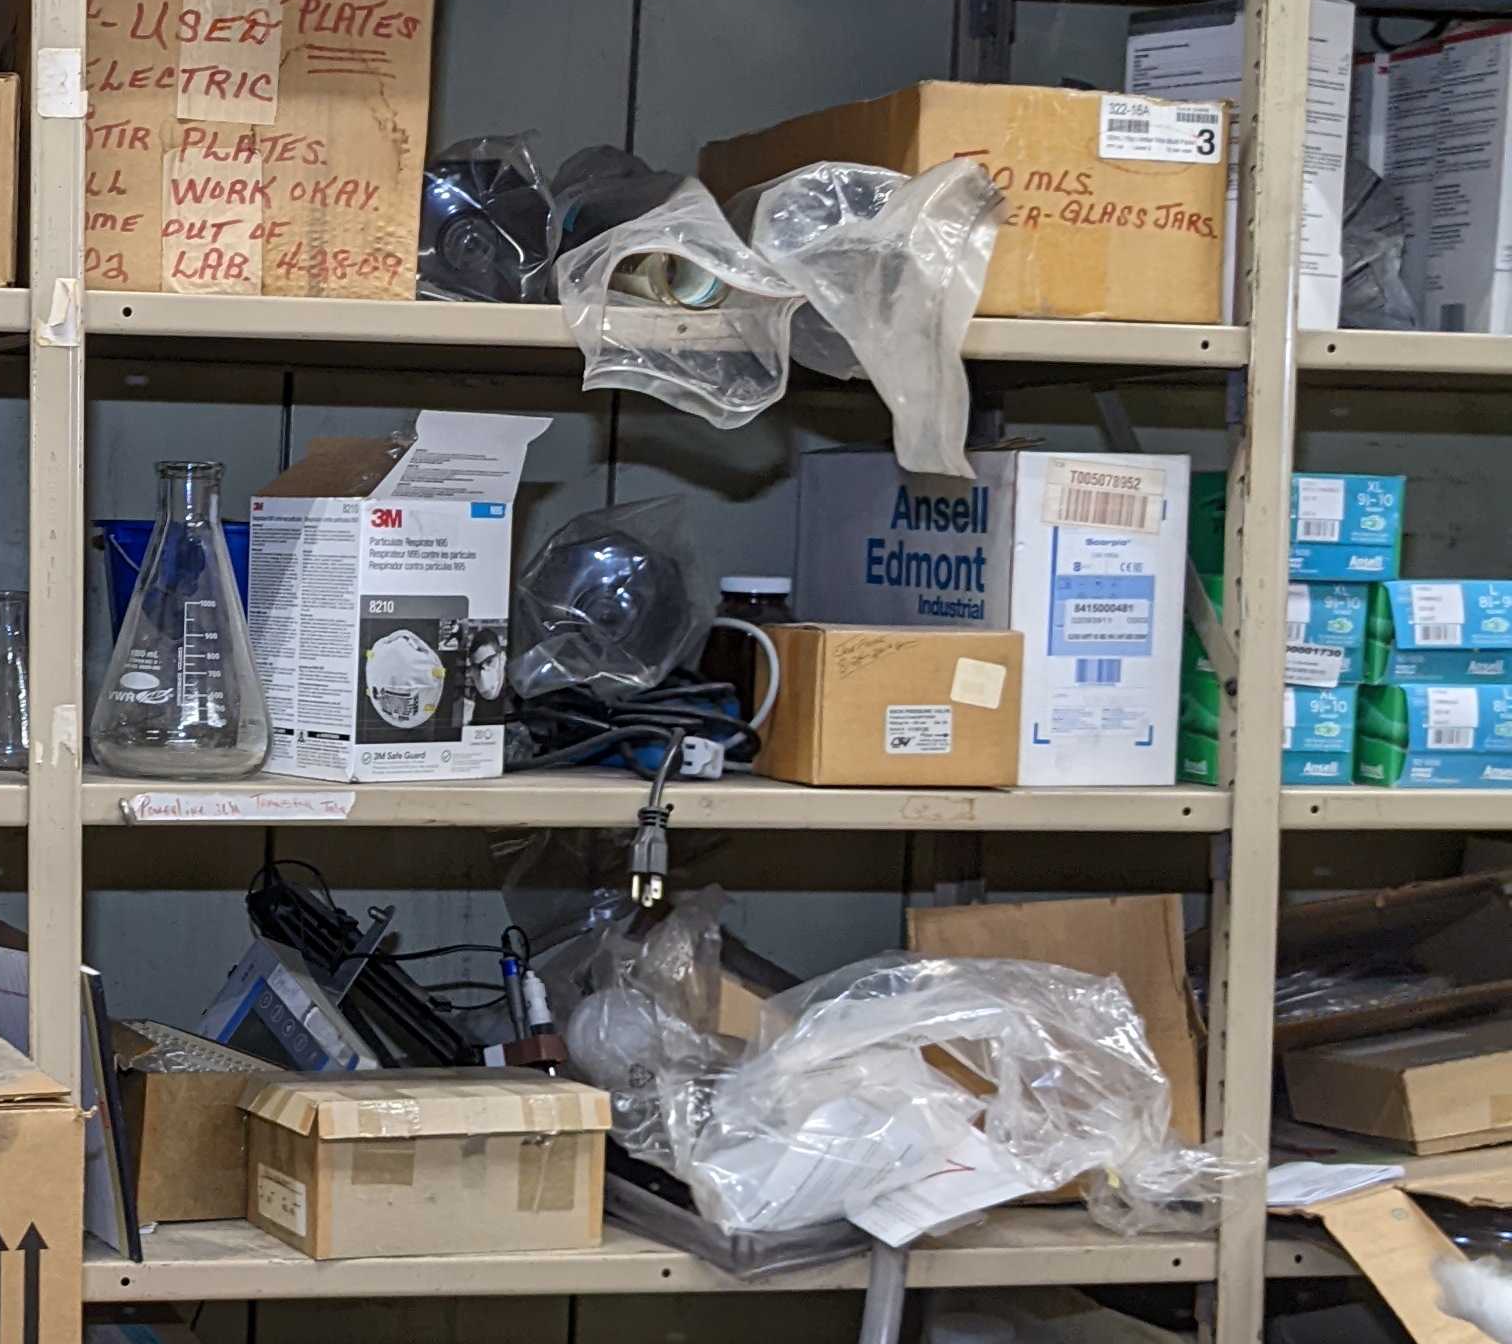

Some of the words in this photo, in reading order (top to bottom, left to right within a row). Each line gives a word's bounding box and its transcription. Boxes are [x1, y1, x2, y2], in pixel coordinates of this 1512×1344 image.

[130, 2, 284, 49] USED
[180, 126, 327, 166] PLATES.
[1196, 129, 1216, 156] 3
[172, 176, 276, 207] WORK
[291, 177, 380, 212] OKAY.
[161, 217, 243, 241] OUT
[249, 219, 292, 243] OF
[1153, 203, 1218, 239] JARS.
[171, 247, 252, 282] LAB.
[1367, 481, 1383, 493] XL
[371, 509, 402, 528] 3M
[891, 485, 988, 533] Ansell
[369, 537, 403, 547] Particulate
[405, 538, 434, 548] Respirator
[435, 538, 448, 547] N95
[369, 550, 406, 560] Respirateur
[450, 550, 477, 560] particules
[369, 562, 403, 572] Respirador
[405, 562, 424, 570] contra
[866, 538, 986, 592] Edmont
[1350, 556, 1384, 570] Ansell
[1334, 586, 1349, 596] XL
[369, 600, 394, 613] 8210
[918, 595, 985, 620] Industrial
[1303, 761, 1338, 775] Ansell
